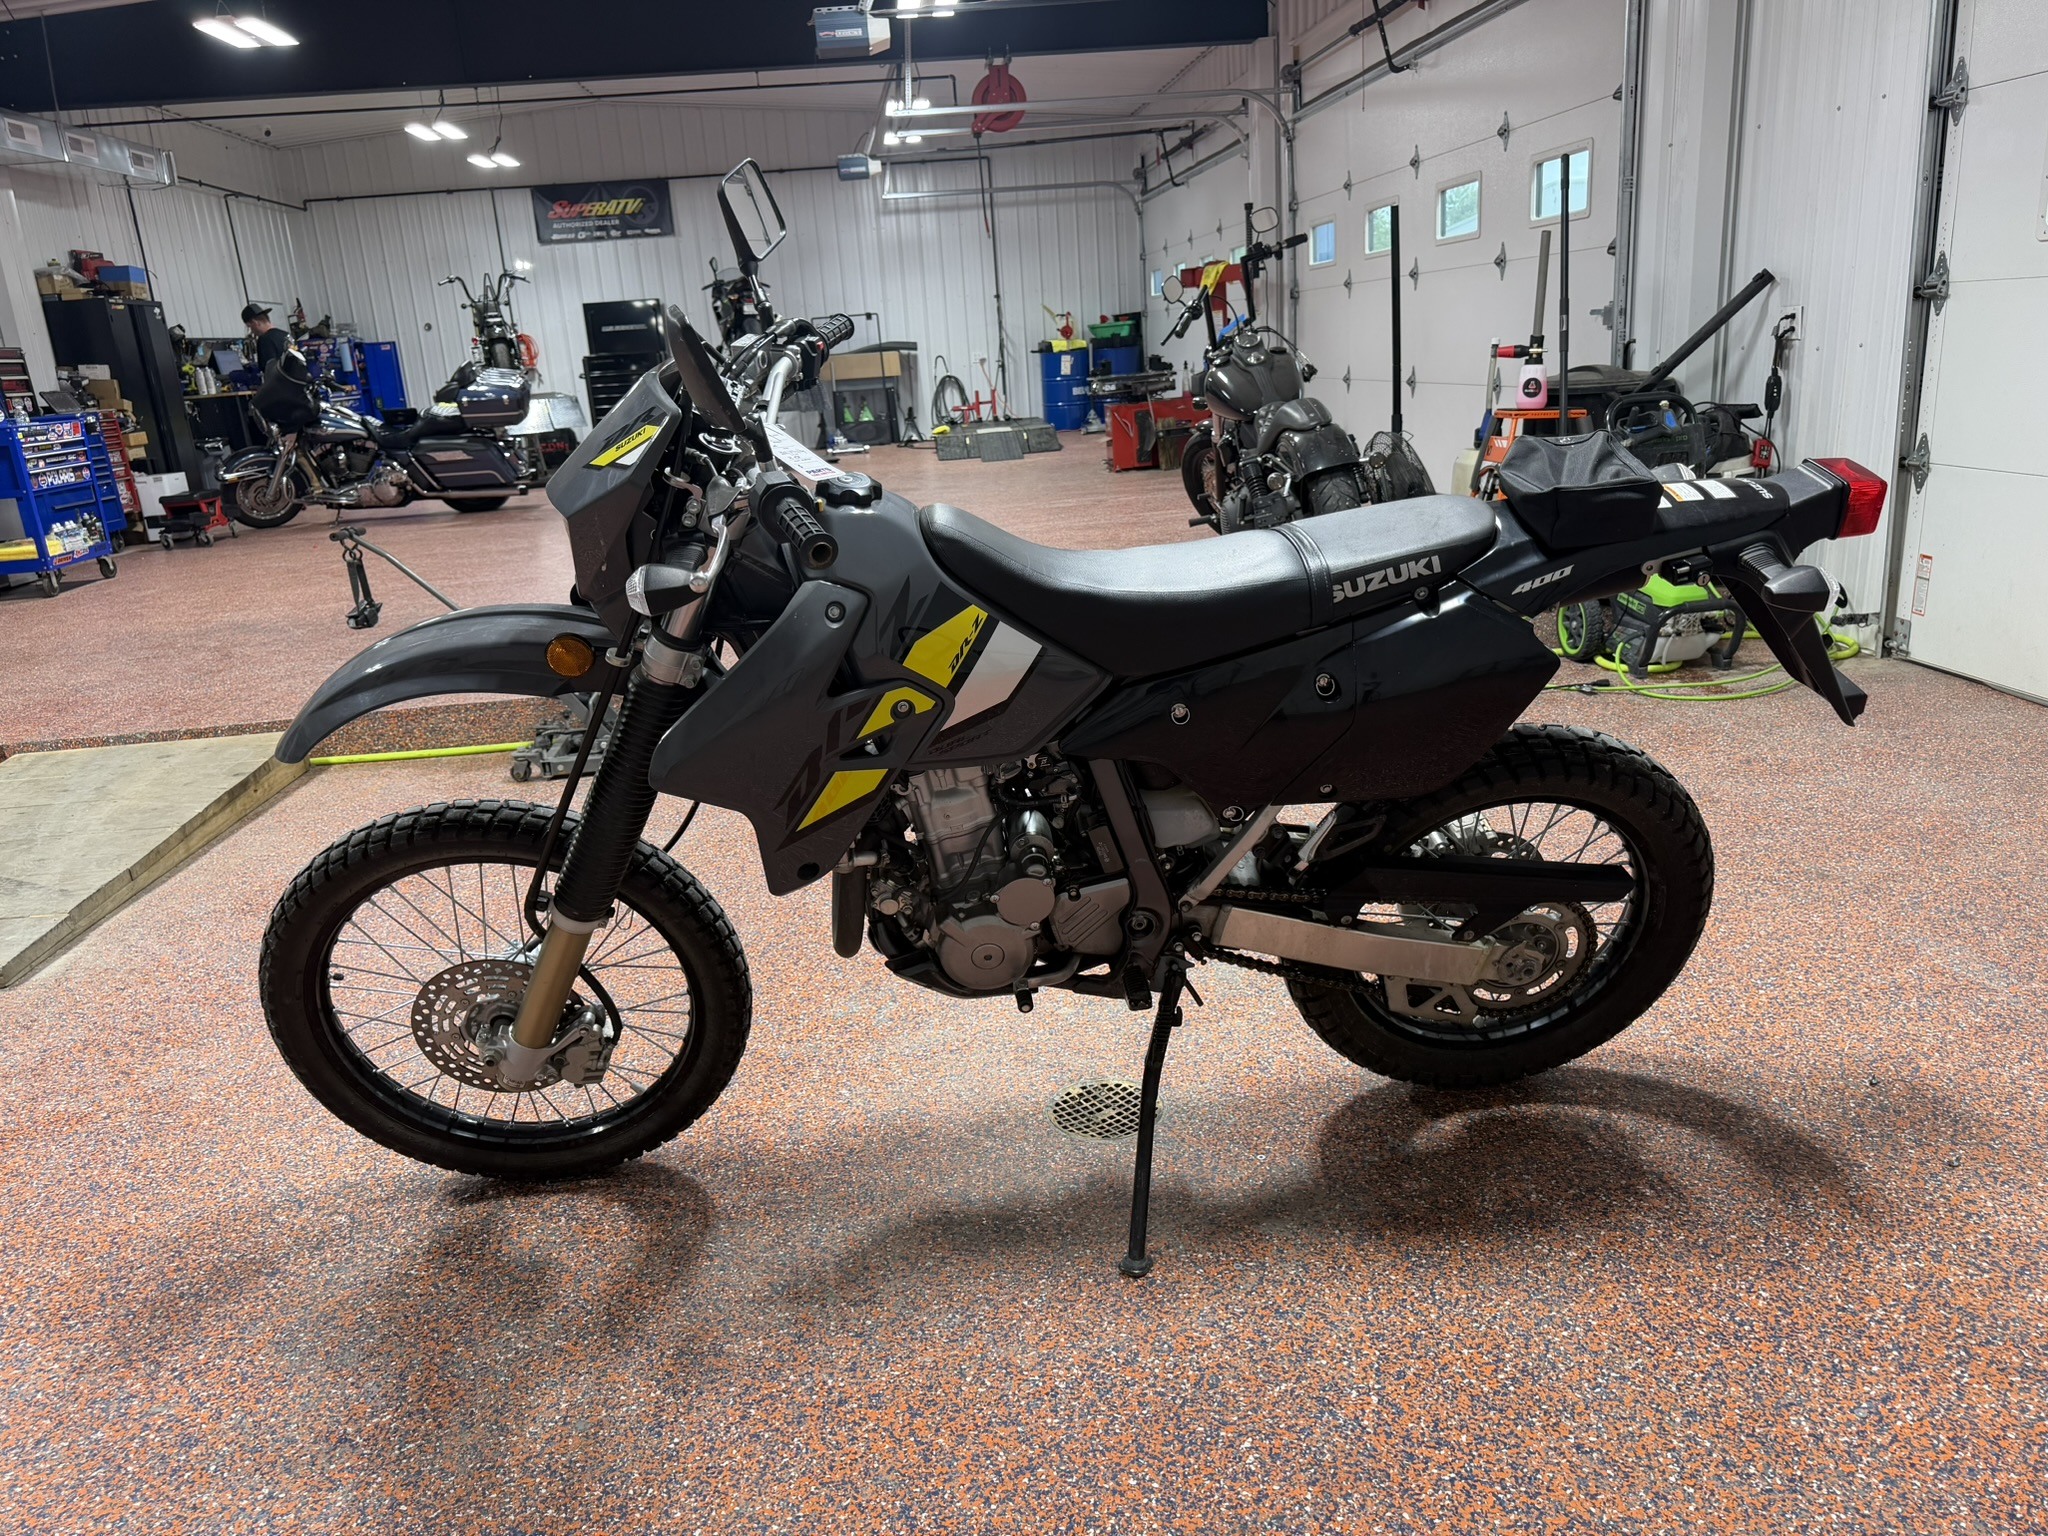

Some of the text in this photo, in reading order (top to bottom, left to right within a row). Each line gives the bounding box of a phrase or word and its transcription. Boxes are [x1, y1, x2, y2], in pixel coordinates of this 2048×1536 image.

[552, 219, 620, 229] AUTHORIZED DEALER
[615, 427, 647, 452] SUZUKI
[46, 468, 75, 486] POLARIS
[1333, 555, 1442, 603] SUZUKI
[1511, 563, 1575, 596] 400
[947, 613, 983, 675] DR-Z
